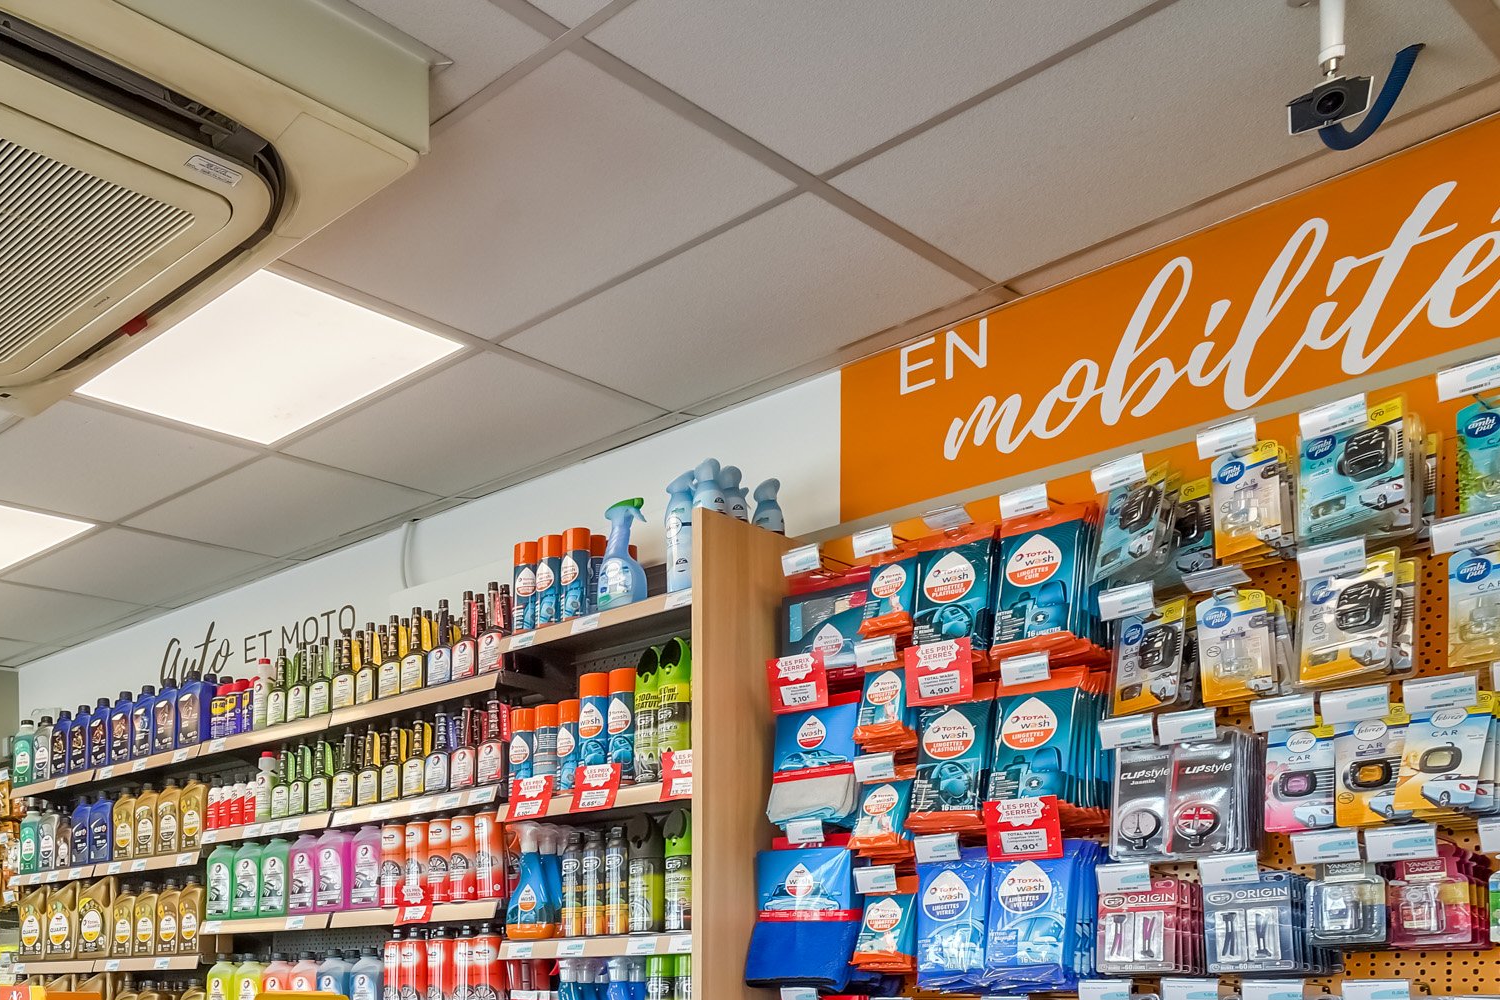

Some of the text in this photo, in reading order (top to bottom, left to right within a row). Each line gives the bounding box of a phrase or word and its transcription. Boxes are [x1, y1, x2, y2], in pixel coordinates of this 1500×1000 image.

[943, 180, 1500, 461] mobilité
[899, 318, 989, 395] EN
[1468, 416, 1498, 431] ambi
[1476, 425, 1491, 437] pur
[1307, 437, 1334, 453] ambi
[1316, 446, 1331, 458] pur
[1219, 463, 1243, 478] ambi
[1226, 473, 1240, 483] pur
[1235, 477, 1257, 490] CAR
[1026, 549, 1053, 557] TOTAL
[1024, 554, 1054, 567] wash
[941, 572, 969, 583] wash
[1016, 566, 1049, 579] LINGETTES
[1024, 573, 1040, 581] CUIR
[931, 587, 966, 598] PLASTIQUES
[933, 583, 964, 592] LINGETTES
[244, 629, 273, 664] ET
[281, 604, 356, 650] MOTO
[936, 644, 954, 652] PRIX
[923, 650, 953, 660] SERRÉS
[783, 664, 809, 672] SERRÉS
[870, 690, 896, 700] LINGETTES
[929, 685, 953, 695] 4,90€
[792, 695, 810, 703] 3,10€
[579, 717, 601, 726] wash
[1435, 712, 1464, 723] febreze
[1020, 720, 1050, 729] wash
[1431, 729, 1458, 738] CAR
[930, 745, 965, 753] PLASTIQUES
[1357, 742, 1383, 751] CAR
[1120, 767, 1170, 780] CLIPstyle
[1179, 762, 1232, 775] CLIPstyle
[1130, 778, 1156, 786] Jasmin
[1020, 801, 1039, 809] PRIX
[1005, 808, 1037, 816] SERRÉS
[1013, 843, 1039, 851] 4,90€
[1016, 883, 1045, 892] wash
[1127, 893, 1175, 903] ORIGIN
[1235, 887, 1288, 899] ORIGIN
[931, 903, 960, 912] LINGETTES
[935, 908, 955, 916] VITRES
